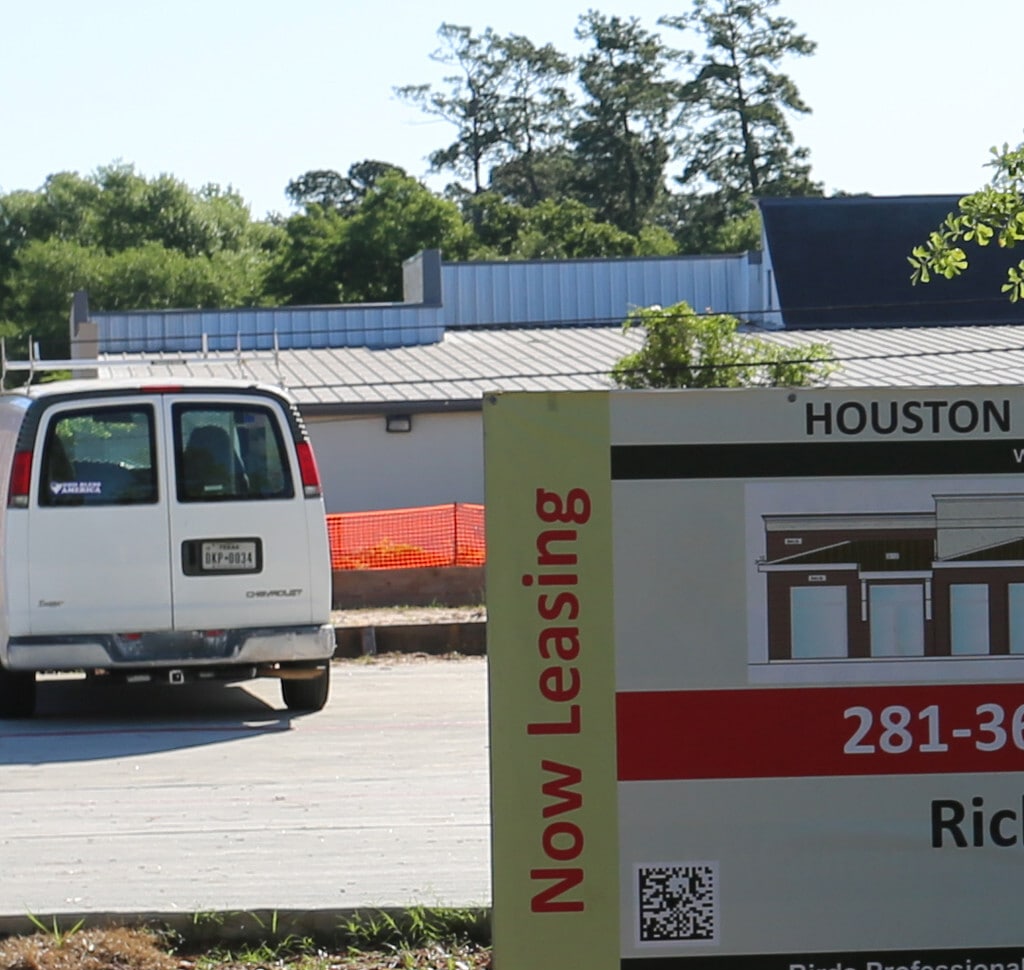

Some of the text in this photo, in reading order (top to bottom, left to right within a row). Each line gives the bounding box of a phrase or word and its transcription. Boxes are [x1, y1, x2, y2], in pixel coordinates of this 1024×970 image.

[805, 400, 1011, 435] HOUSTON
[521, 487, 592, 913] Now Leasing
